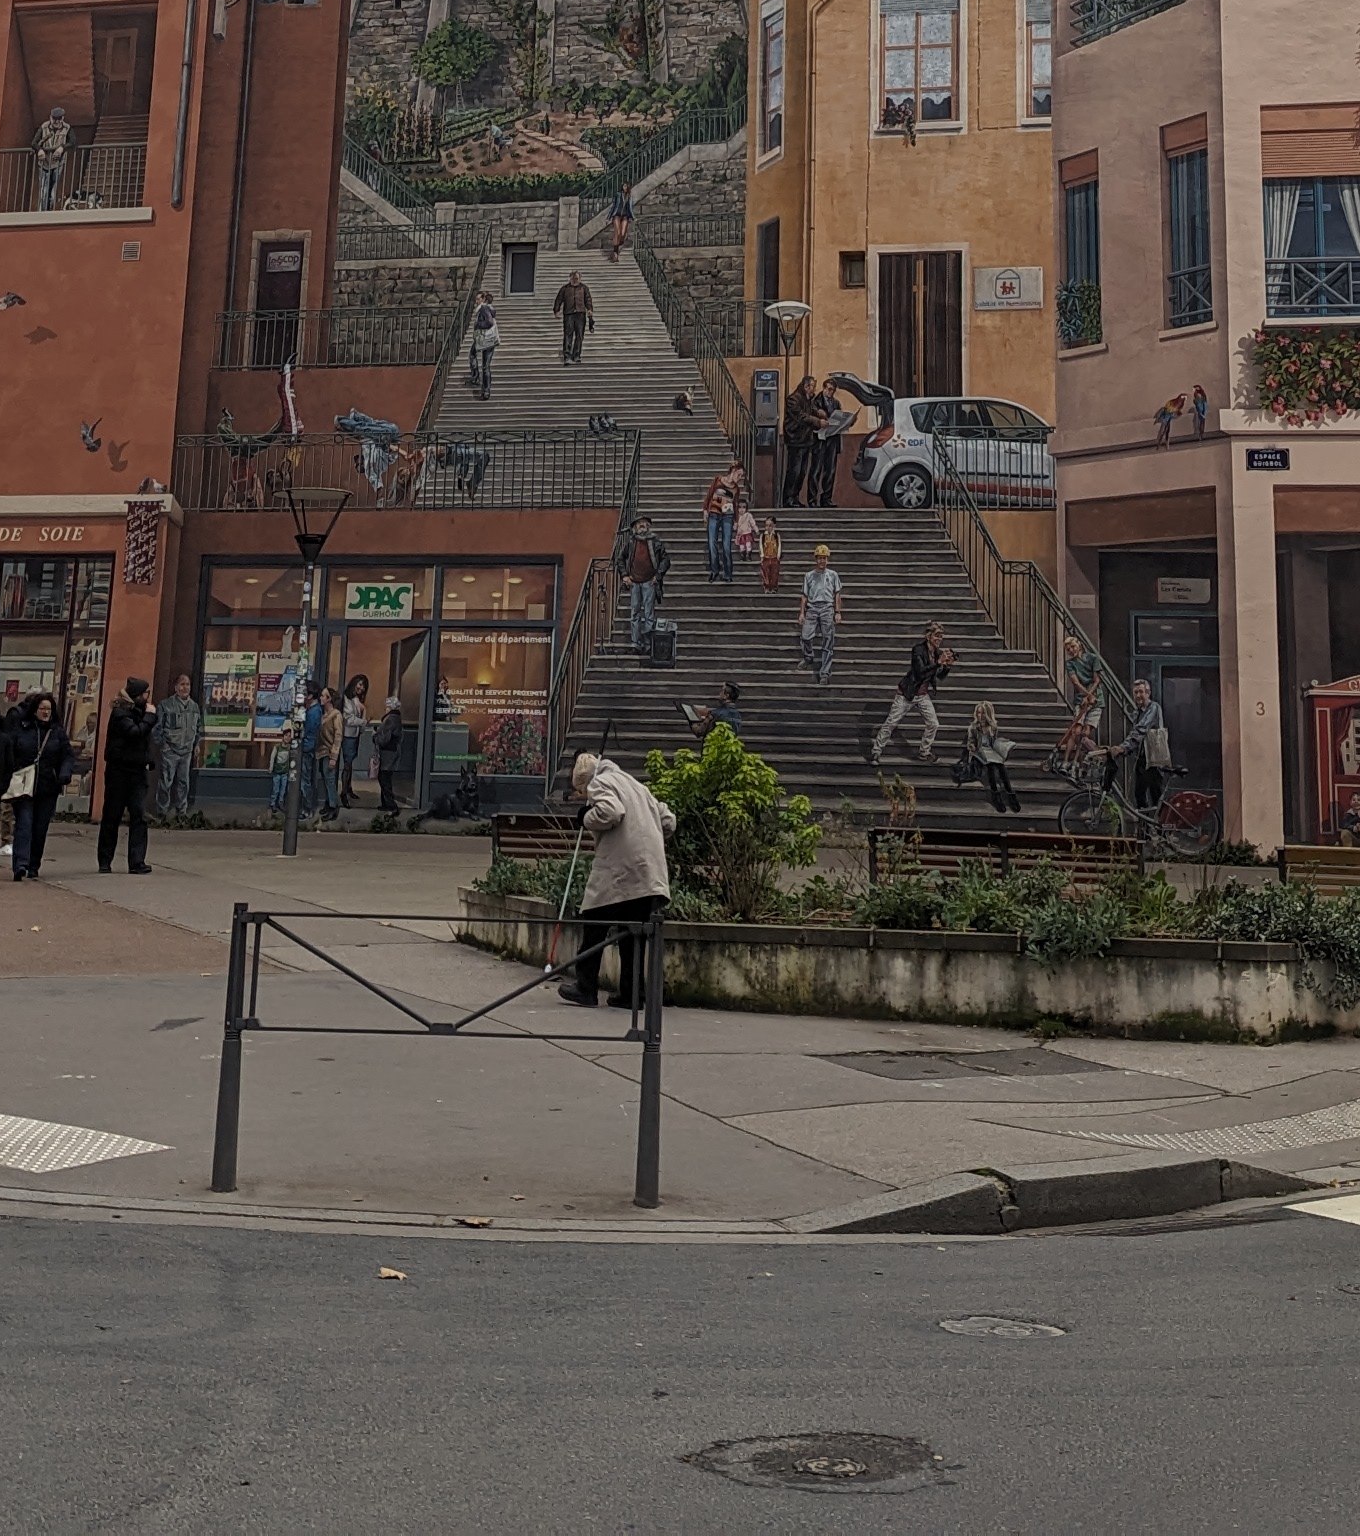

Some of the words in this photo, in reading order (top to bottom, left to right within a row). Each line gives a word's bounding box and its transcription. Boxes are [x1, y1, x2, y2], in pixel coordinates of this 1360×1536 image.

[1253, 460, 1284, 468] GUIGNOL
[38, 526, 85, 542] SOIE
[347, 585, 412, 611] OPAC
[451, 634, 483, 643] bailleur
[485, 634, 497, 643] du
[498, 634, 552, 645] département
[1255, 701, 1266, 716] 3
